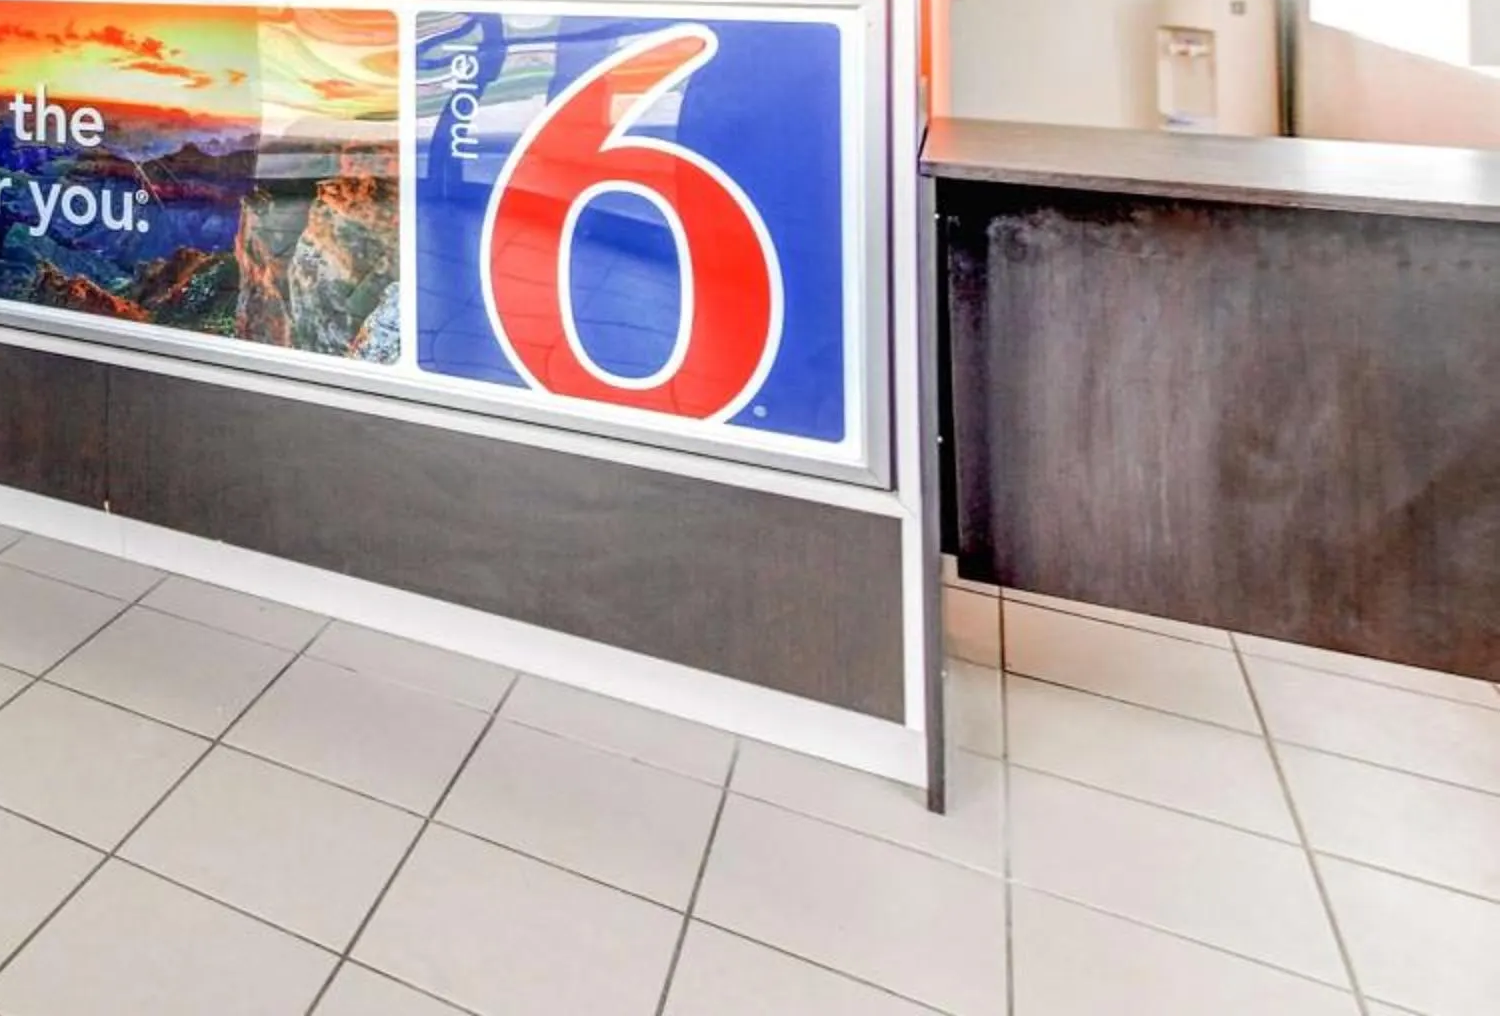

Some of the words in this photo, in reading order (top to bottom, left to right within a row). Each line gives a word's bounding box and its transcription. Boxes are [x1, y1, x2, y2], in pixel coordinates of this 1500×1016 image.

[10, 84, 104, 147] the
[443, 44, 479, 159] motel
[479, 22, 784, 424] 6
